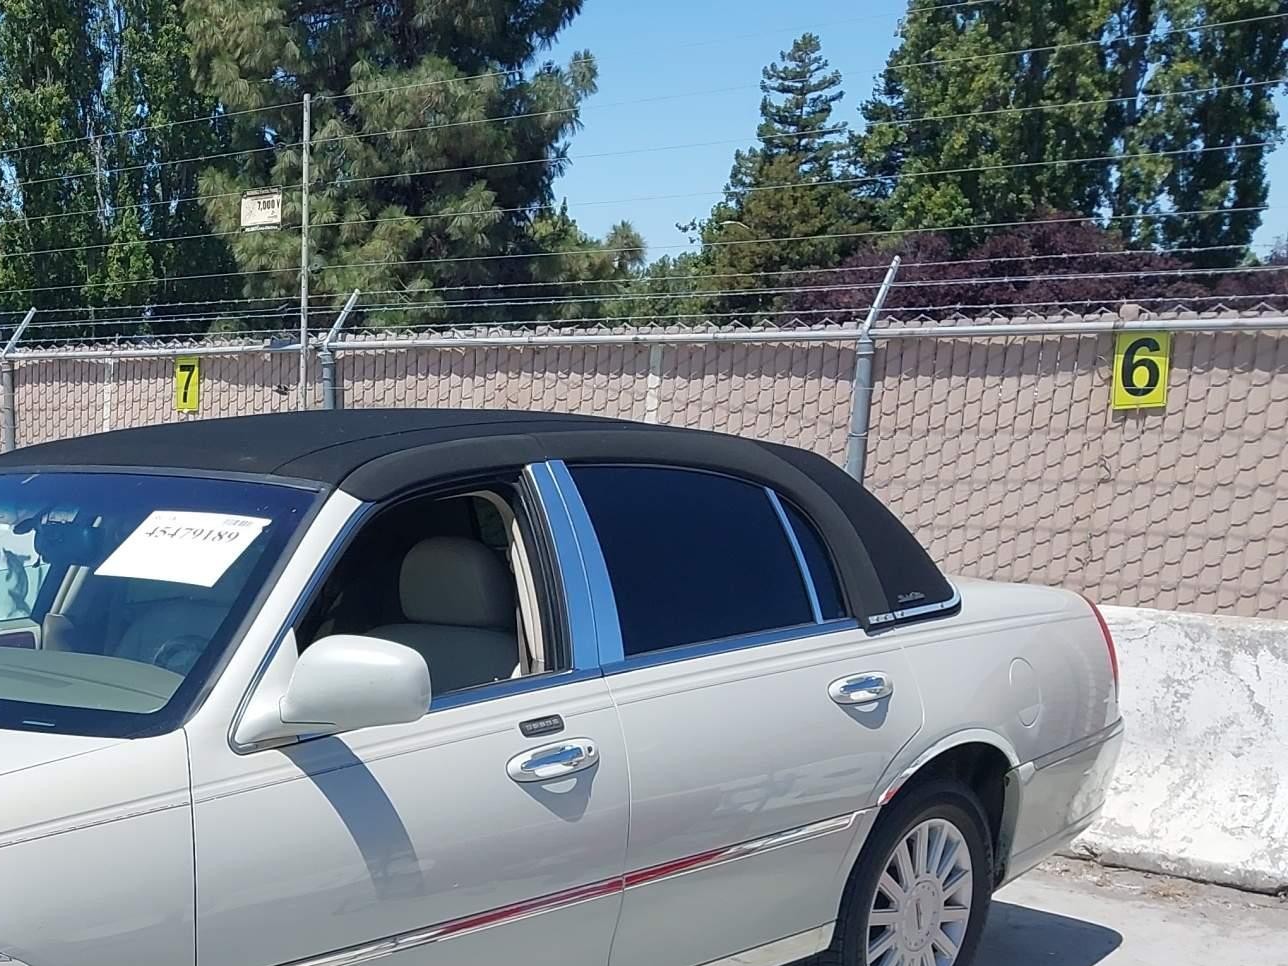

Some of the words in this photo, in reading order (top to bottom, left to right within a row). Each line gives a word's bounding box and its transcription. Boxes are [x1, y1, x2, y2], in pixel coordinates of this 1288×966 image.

[179, 364, 195, 403] 7
[1122, 337, 1160, 396] 6
[146, 526, 240, 543] 45479189
